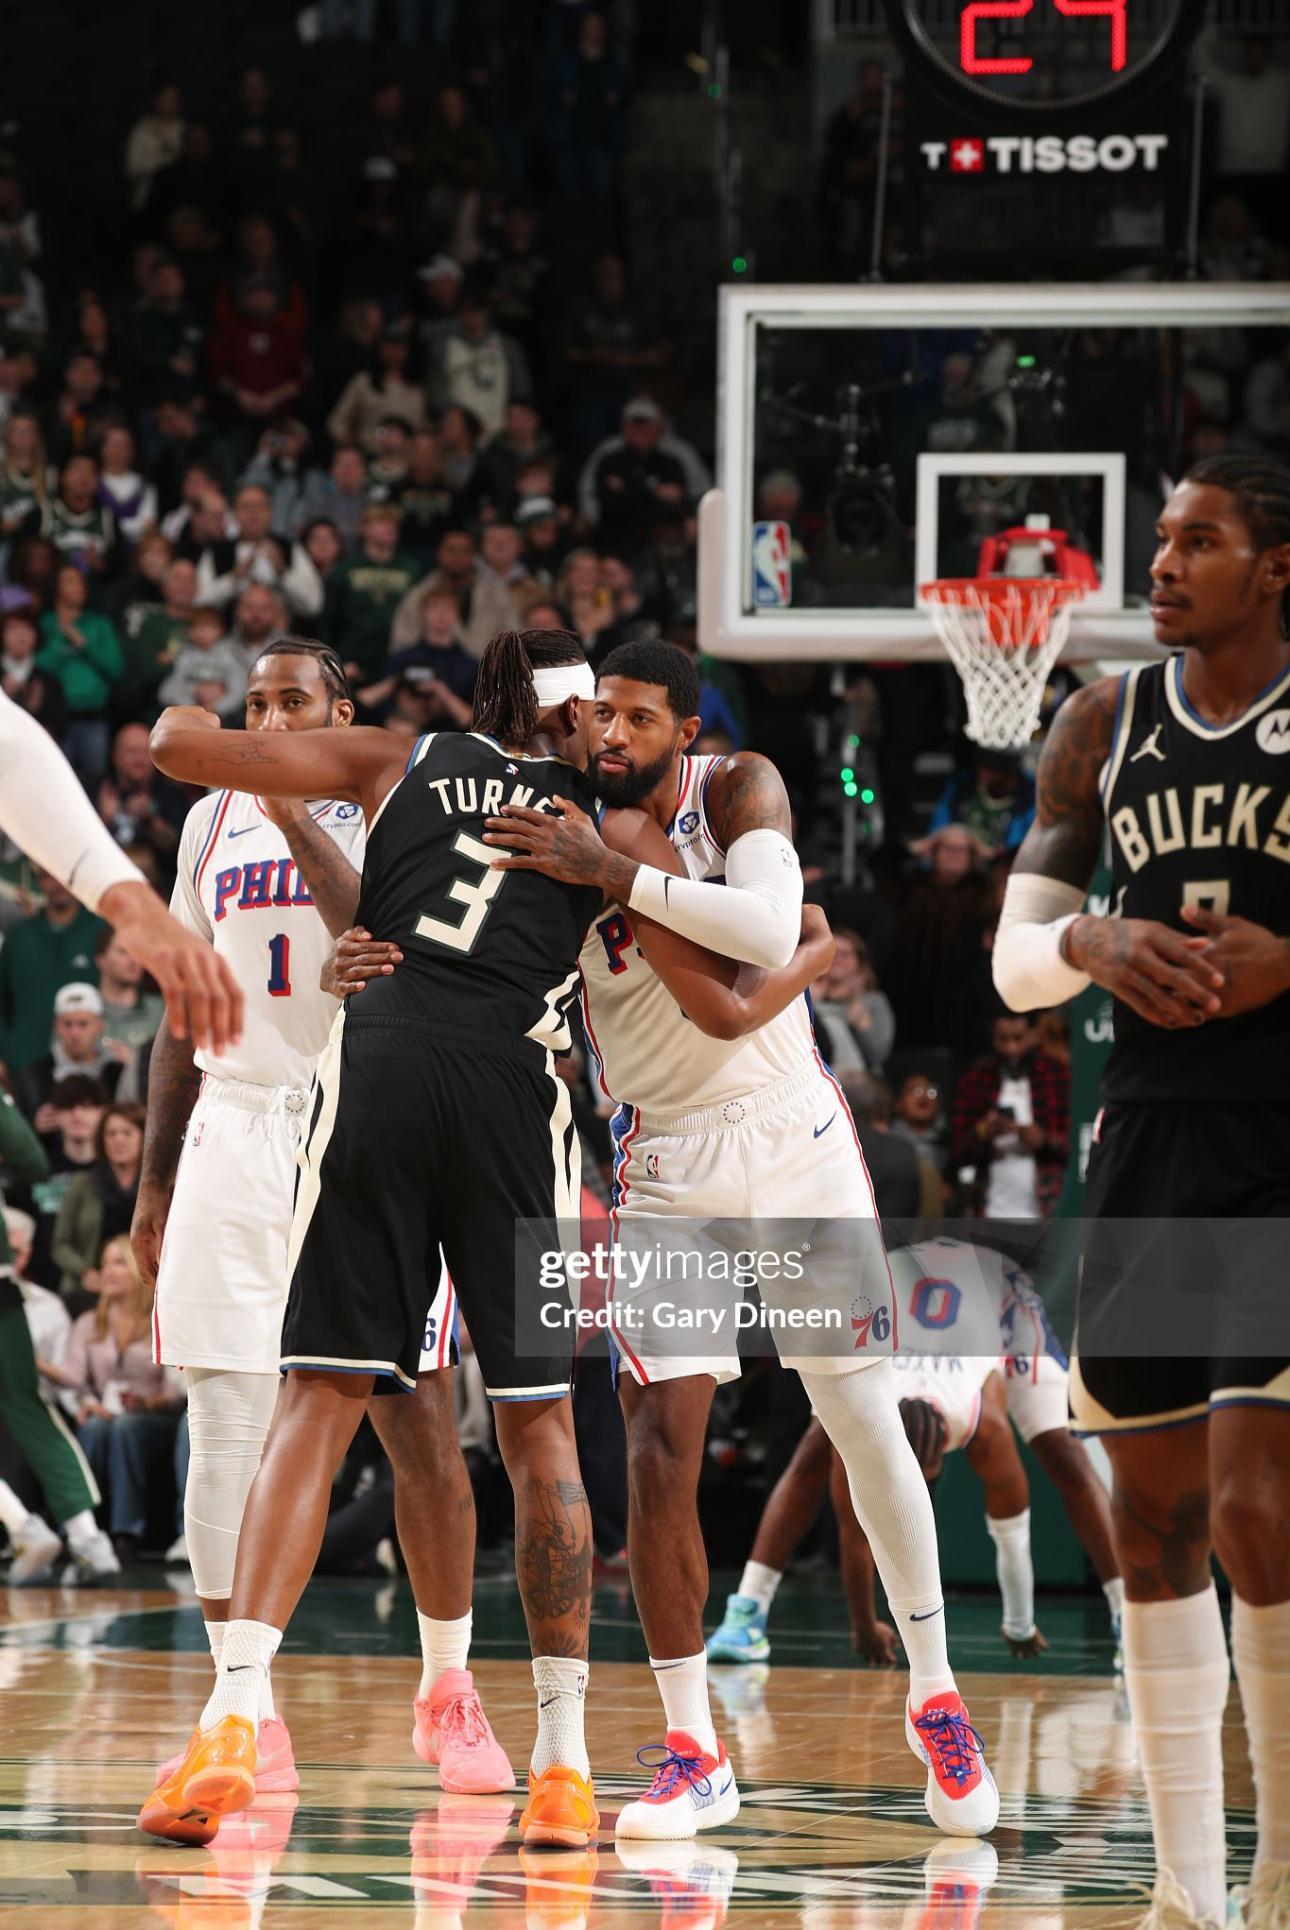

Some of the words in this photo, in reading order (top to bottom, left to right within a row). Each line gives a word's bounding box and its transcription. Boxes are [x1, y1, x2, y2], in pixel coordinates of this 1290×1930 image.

[987, 134, 1168, 173] TISSOT
[414, 831, 513, 953] 3
[268, 933, 291, 996] 1
[419, 1317, 437, 1352] 6
[851, 1306, 890, 1350] 76
